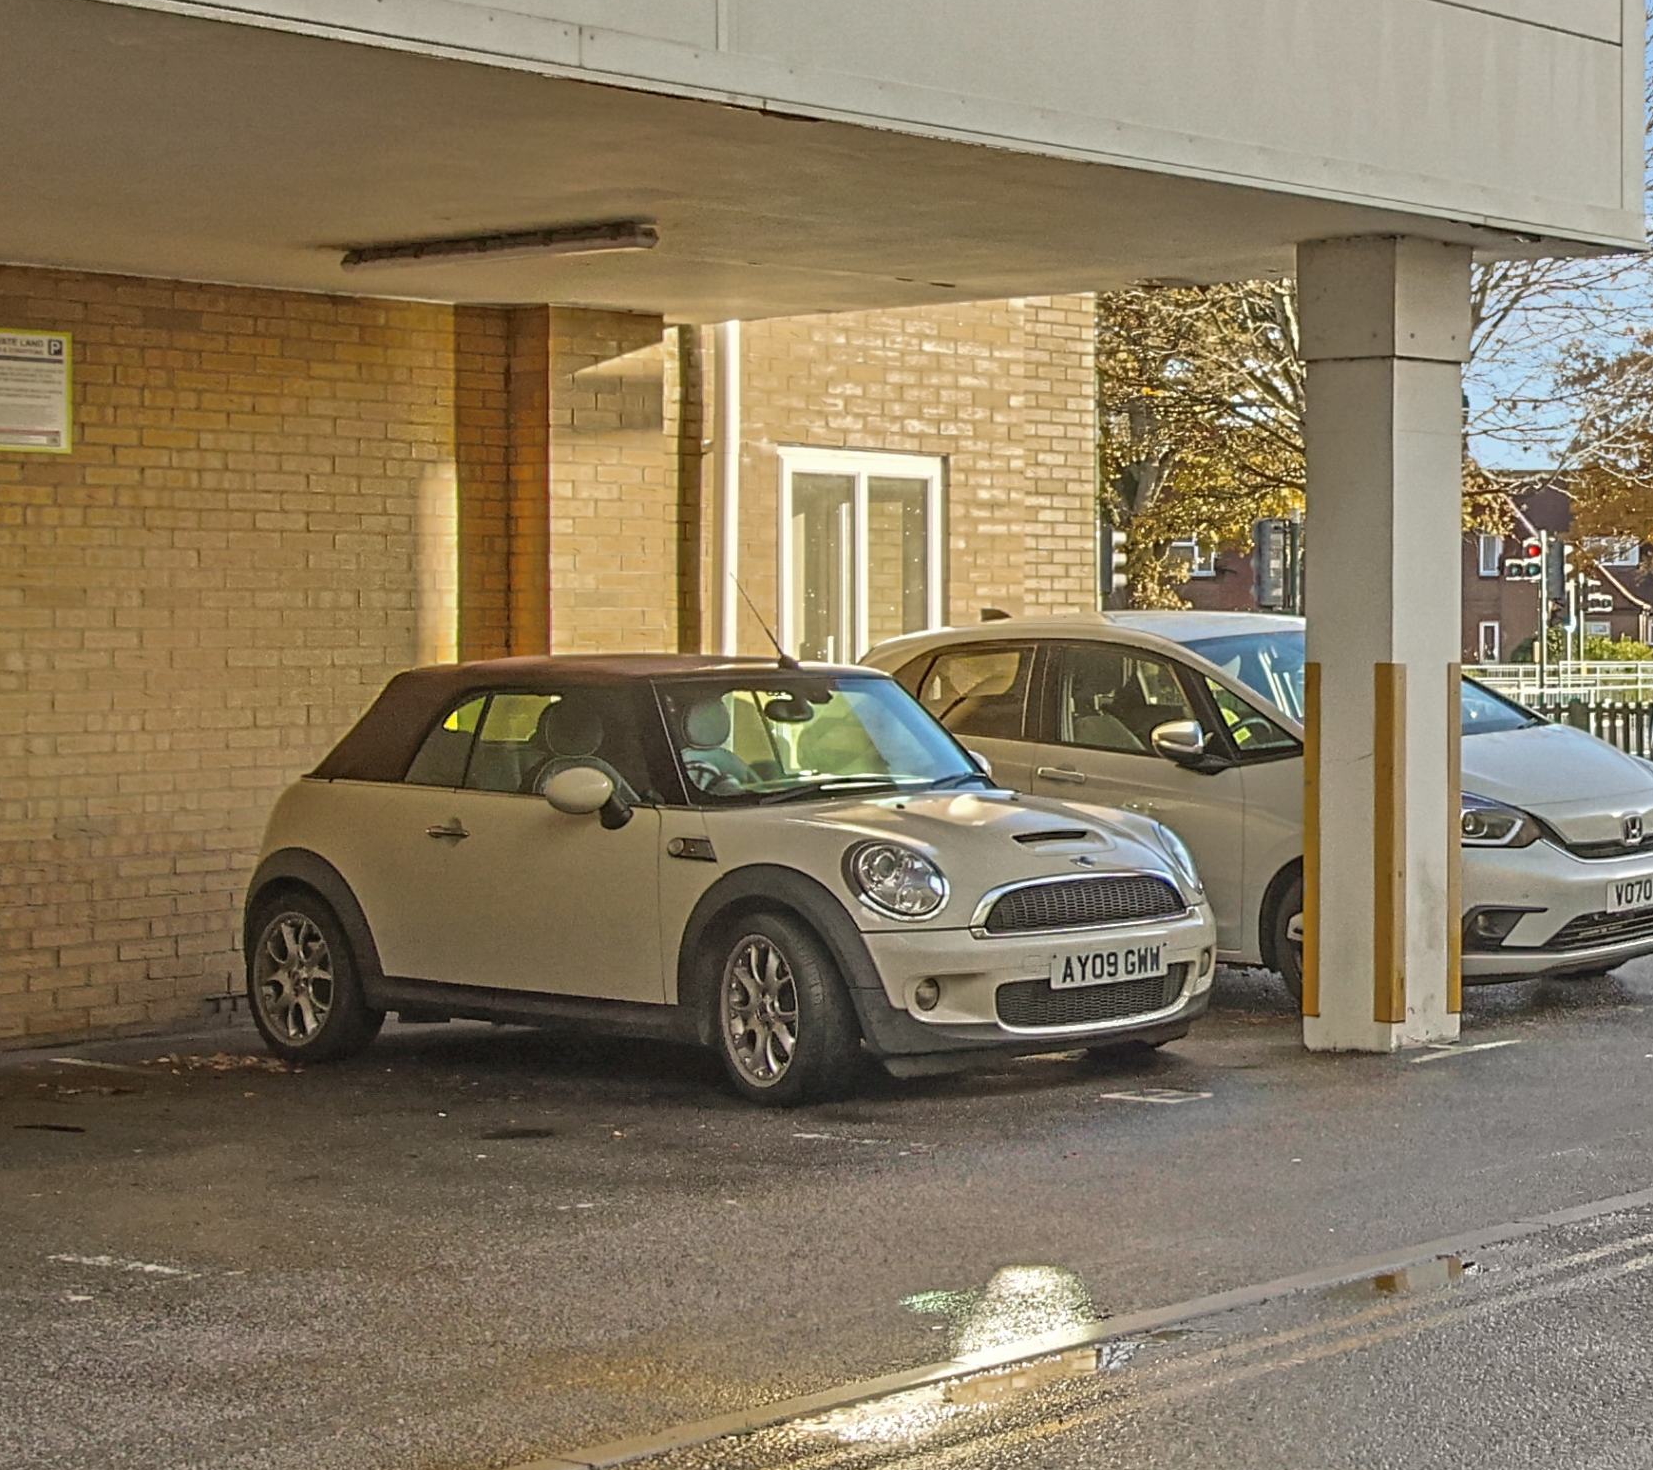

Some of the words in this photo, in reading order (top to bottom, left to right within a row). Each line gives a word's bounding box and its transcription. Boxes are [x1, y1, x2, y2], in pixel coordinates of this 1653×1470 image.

[19, 339, 44, 347] LAND
[1615, 879, 1653, 907] VO70
[1061, 951, 1118, 984] AY09
[1124, 945, 1161, 976] GWW
